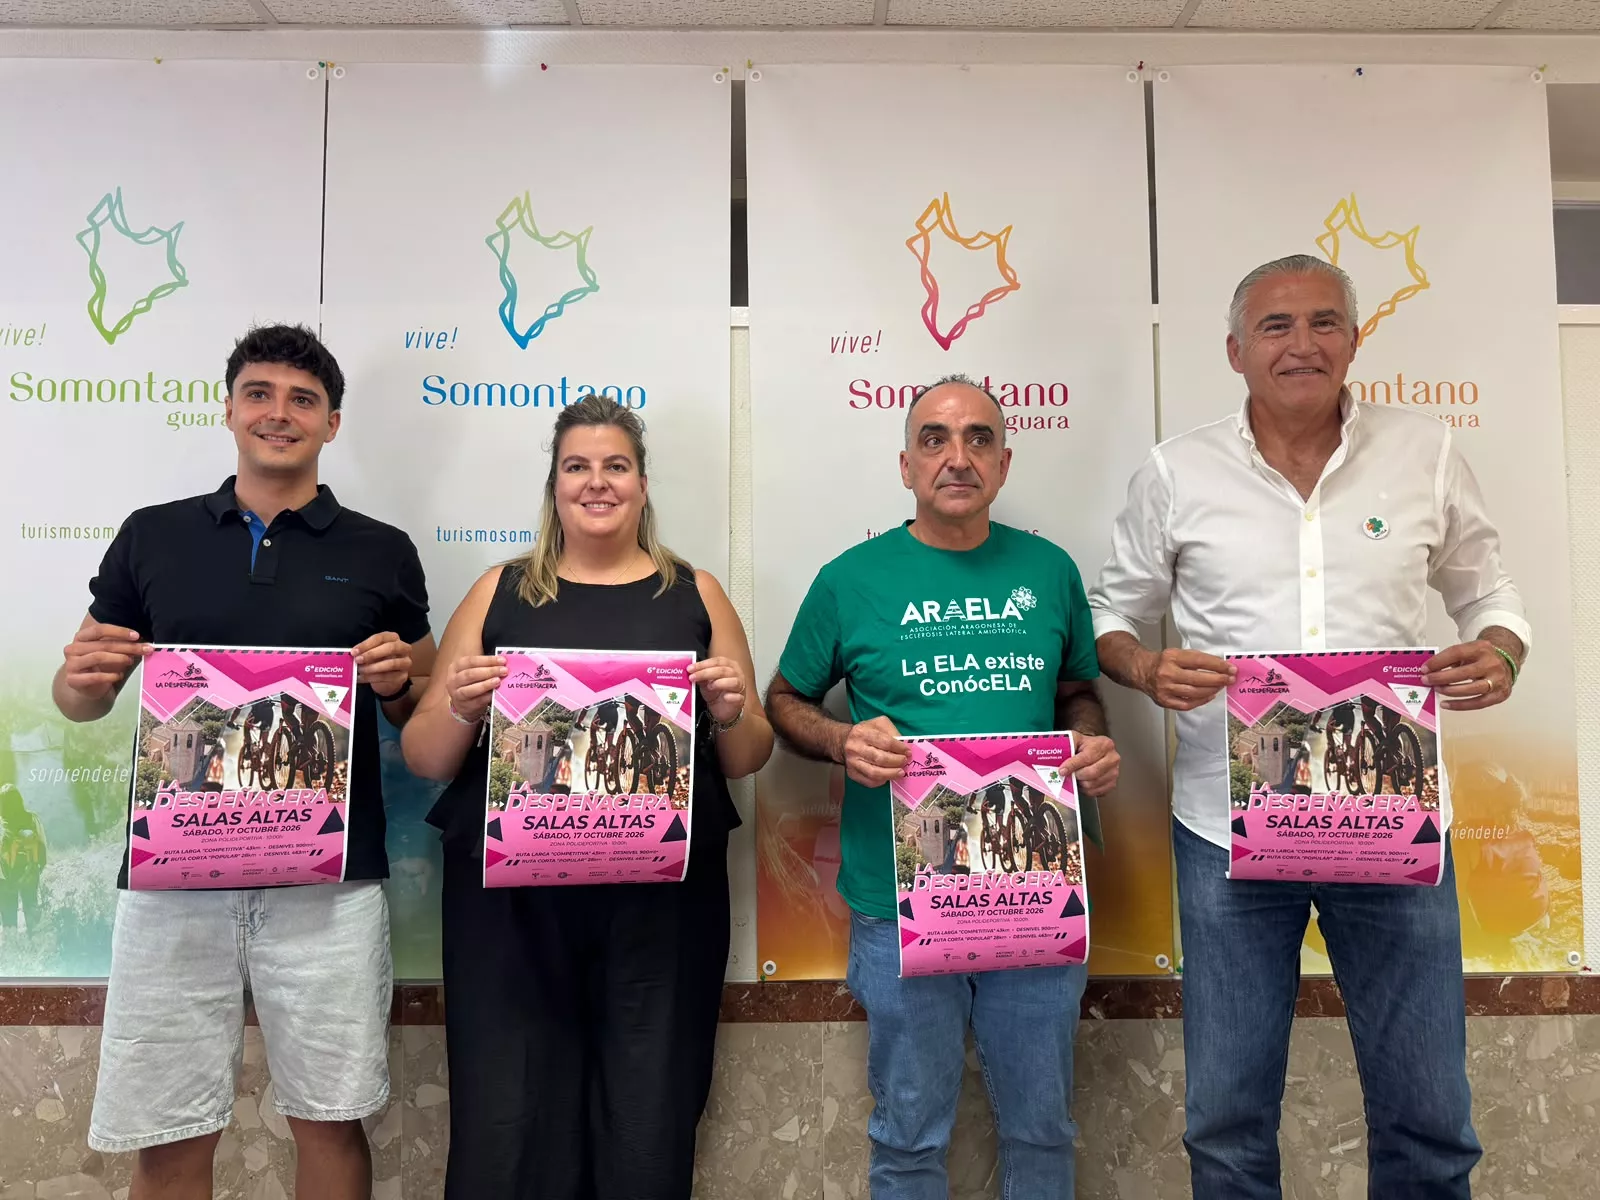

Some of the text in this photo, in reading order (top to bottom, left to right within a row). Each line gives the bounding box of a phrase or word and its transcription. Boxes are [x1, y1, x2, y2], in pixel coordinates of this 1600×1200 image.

[0, 323, 46, 346] ive!
[404, 326, 458, 350] vive!
[830, 330, 882, 354] vive!
[422, 375, 646, 409] Somontano
[848, 375, 1069, 410] Somtano
[1348, 373, 1479, 405] ontano
[1005, 414, 1070, 435] guara
[21, 523, 120, 539] turismosom
[324, 575, 349, 583] GANT
[900, 597, 1024, 626] ARAELA
[900, 631, 943, 640] ESCLEROSIS
[909, 624, 957, 633] ASOCIACIÓN
[960, 622, 1006, 630] ARAGONESA
[901, 652, 1045, 677] La ELA existe
[919, 674, 1032, 696] ConócELA
[157, 779, 180, 792] LA
[510, 781, 531, 794] LA
[1250, 781, 1271, 794] LA
[151, 787, 329, 811] DESPEÑACERA
[504, 790, 672, 812] DESPEÑACERA
[1247, 790, 1421, 812] DESPEÑACERA
[171, 808, 313, 828] SALAS ALTAS
[522, 814, 656, 830] SALAS ALTAS
[1265, 814, 1404, 830] SALAS ALTAS
[182, 828, 224, 837] SÁBADO,
[237, 826, 280, 834] OCTUBRE
[281, 824, 301, 832] 2026
[532, 831, 571, 840] SÁBADO,
[1276, 830, 1316, 839] SÁBADO,
[1328, 831, 1371, 839] OCTUBRE
[914, 862, 935, 875] LA
[912, 869, 1067, 893] DESPEÑACERA
[930, 891, 1053, 910] SALAS ALTAS
[940, 909, 976, 918] SÁBADO,
[986, 908, 1024, 916] OCTUBRE
